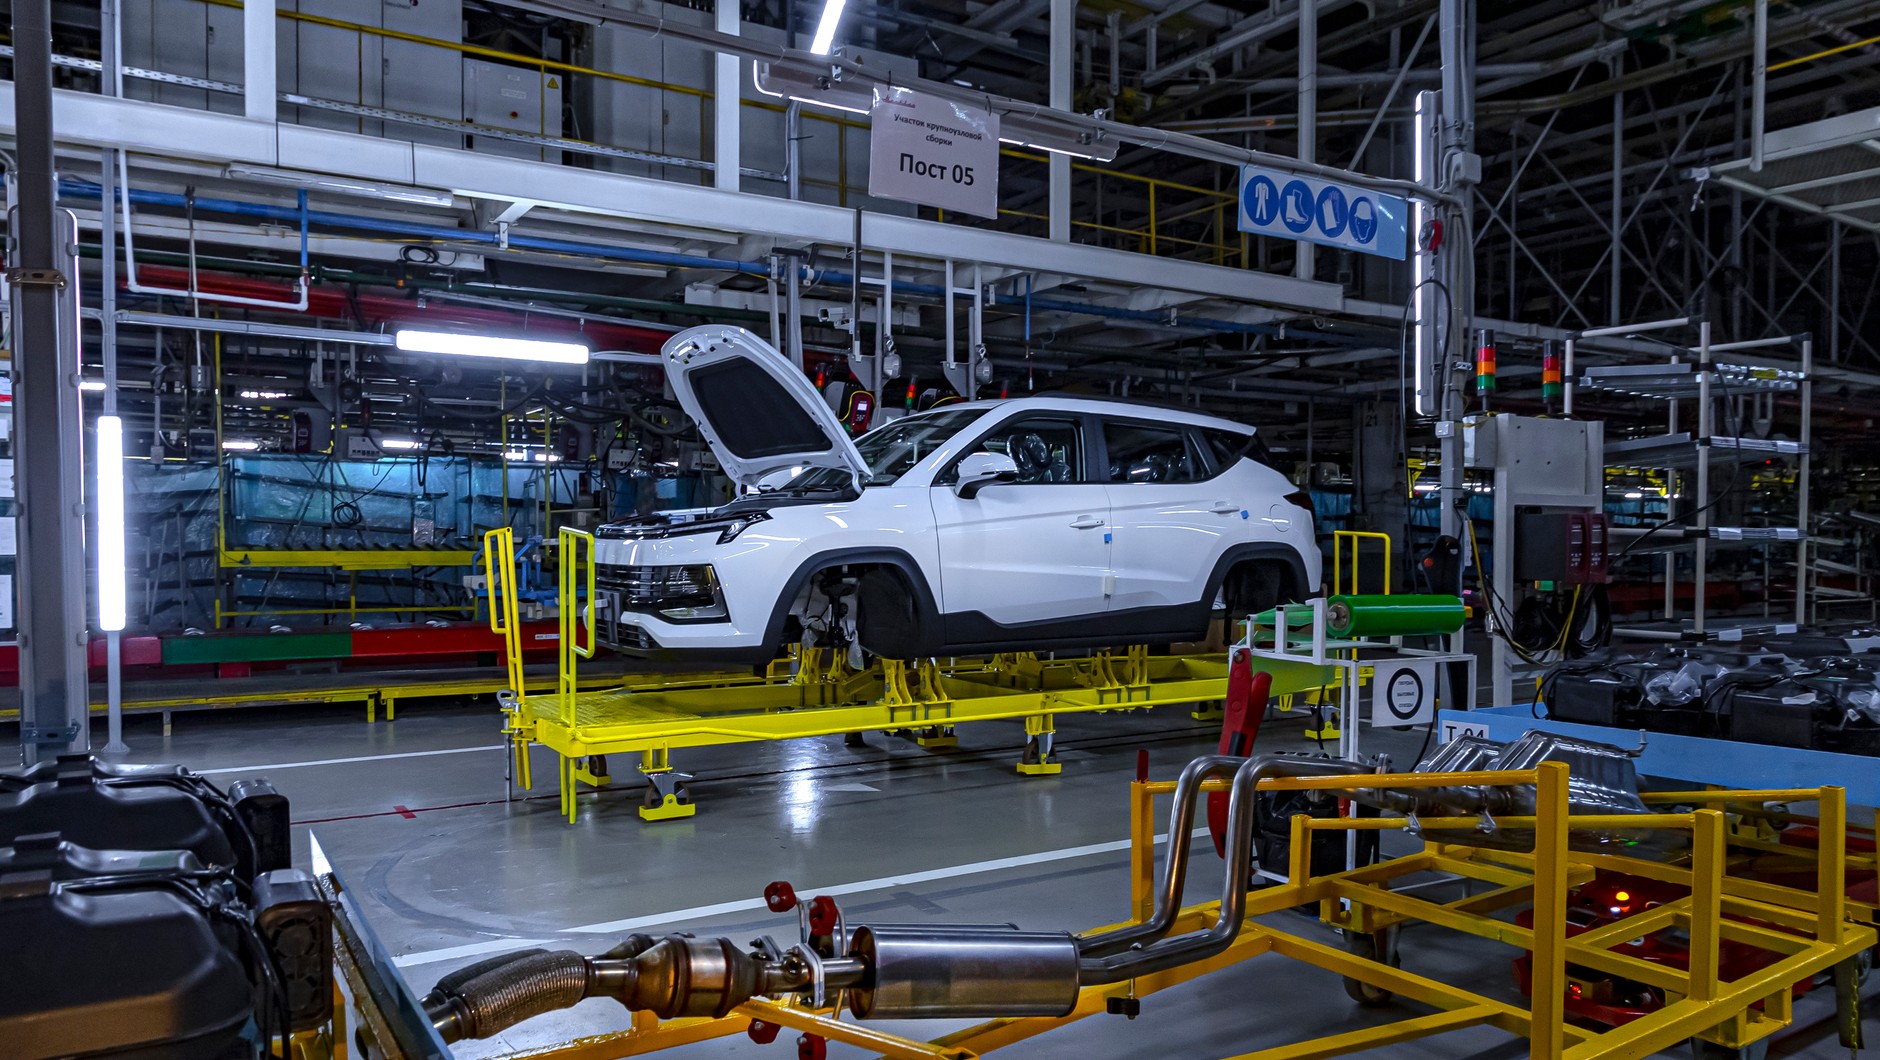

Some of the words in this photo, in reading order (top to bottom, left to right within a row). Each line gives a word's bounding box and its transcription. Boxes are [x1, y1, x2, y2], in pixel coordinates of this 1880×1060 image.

[894, 113, 925, 127] Участок
[926, 122, 983, 141] крупноузловой
[925, 134, 953, 146] сборки
[899, 152, 947, 180] Пост
[952, 164, 975, 186] 05
